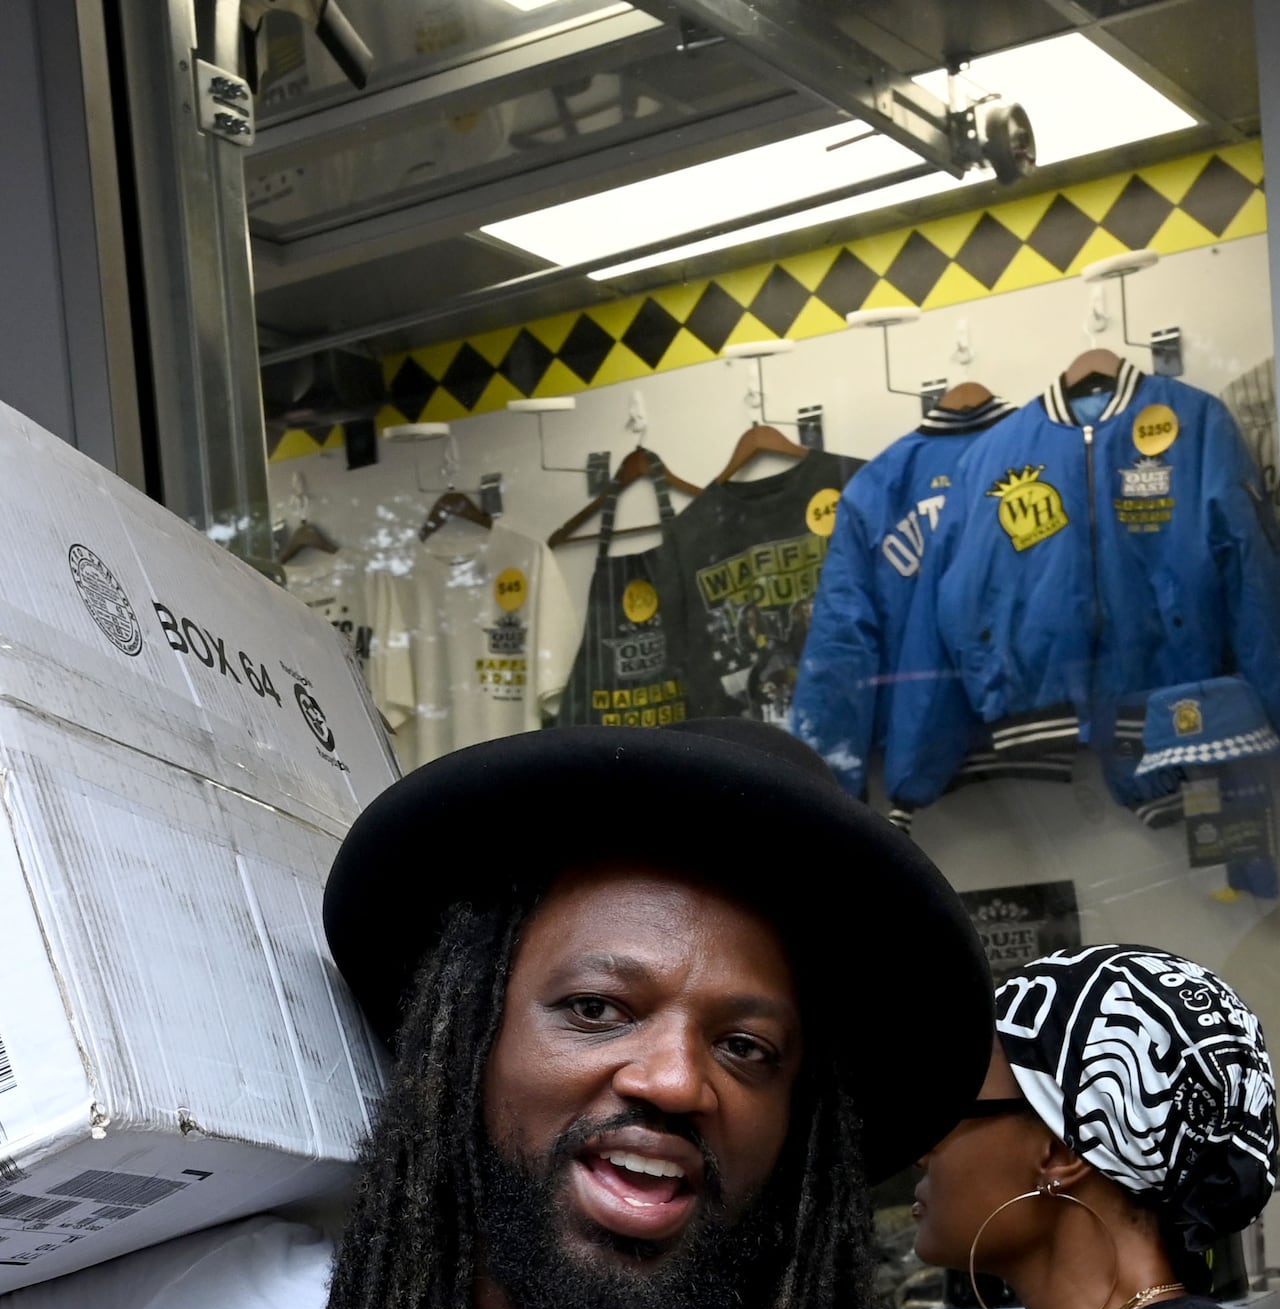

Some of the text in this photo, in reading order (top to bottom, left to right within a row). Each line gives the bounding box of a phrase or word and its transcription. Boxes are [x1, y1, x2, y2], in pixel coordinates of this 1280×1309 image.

[1138, 421, 1170, 438] $250
[882, 495, 946, 577] OUT
[706, 544, 829, 596] WAFFL
[151, 600, 242, 684] BOX
[238, 651, 283, 708] 64
[989, 946, 1034, 961] AST
